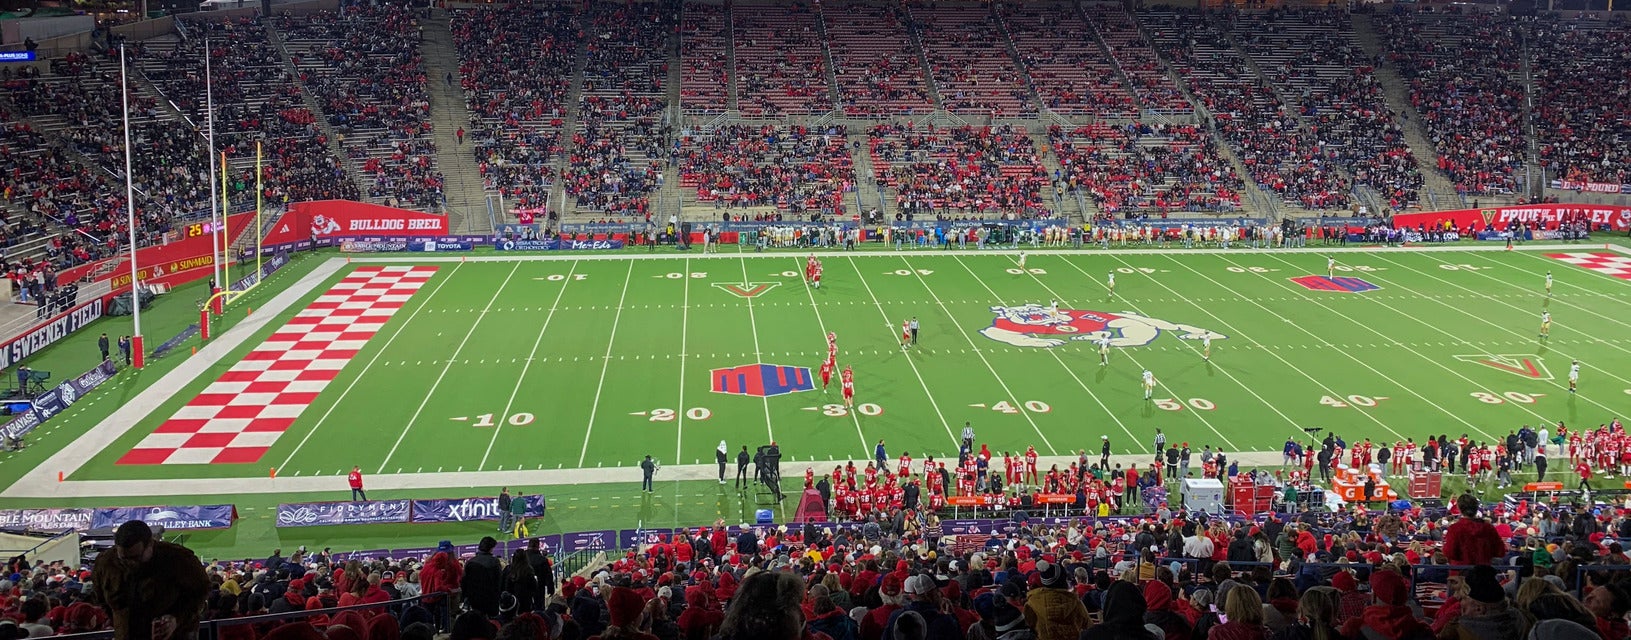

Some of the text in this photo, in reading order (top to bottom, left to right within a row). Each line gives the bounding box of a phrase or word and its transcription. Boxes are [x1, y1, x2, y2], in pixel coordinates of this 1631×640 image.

[1499, 209, 1542, 222] PRIDE
[189, 224, 202, 237] 25
[349, 218, 442, 230] BULLDOG BRED.
[13, 316, 68, 362] SWEENEY
[71, 299, 102, 332] FIELD
[1320, 395, 1377, 407] 40
[1469, 391, 1537, 404] 30
[822, 403, 884, 417] 30
[992, 400, 1051, 414] 40
[1153, 398, 1217, 411] 50
[472, 412, 536, 427] 10
[649, 408, 712, 421] 20
[1345, 487, 1356, 498] G
[1373, 487, 1384, 498] G
[320, 502, 406, 512] FIDDYMENT
[934, 497, 942, 506] 71
[448, 498, 500, 521] xfinit
[22, 512, 91, 523] MOUNTAIN
[188, 520, 212, 528] BANK
[40, 521, 79, 529] RESORT
